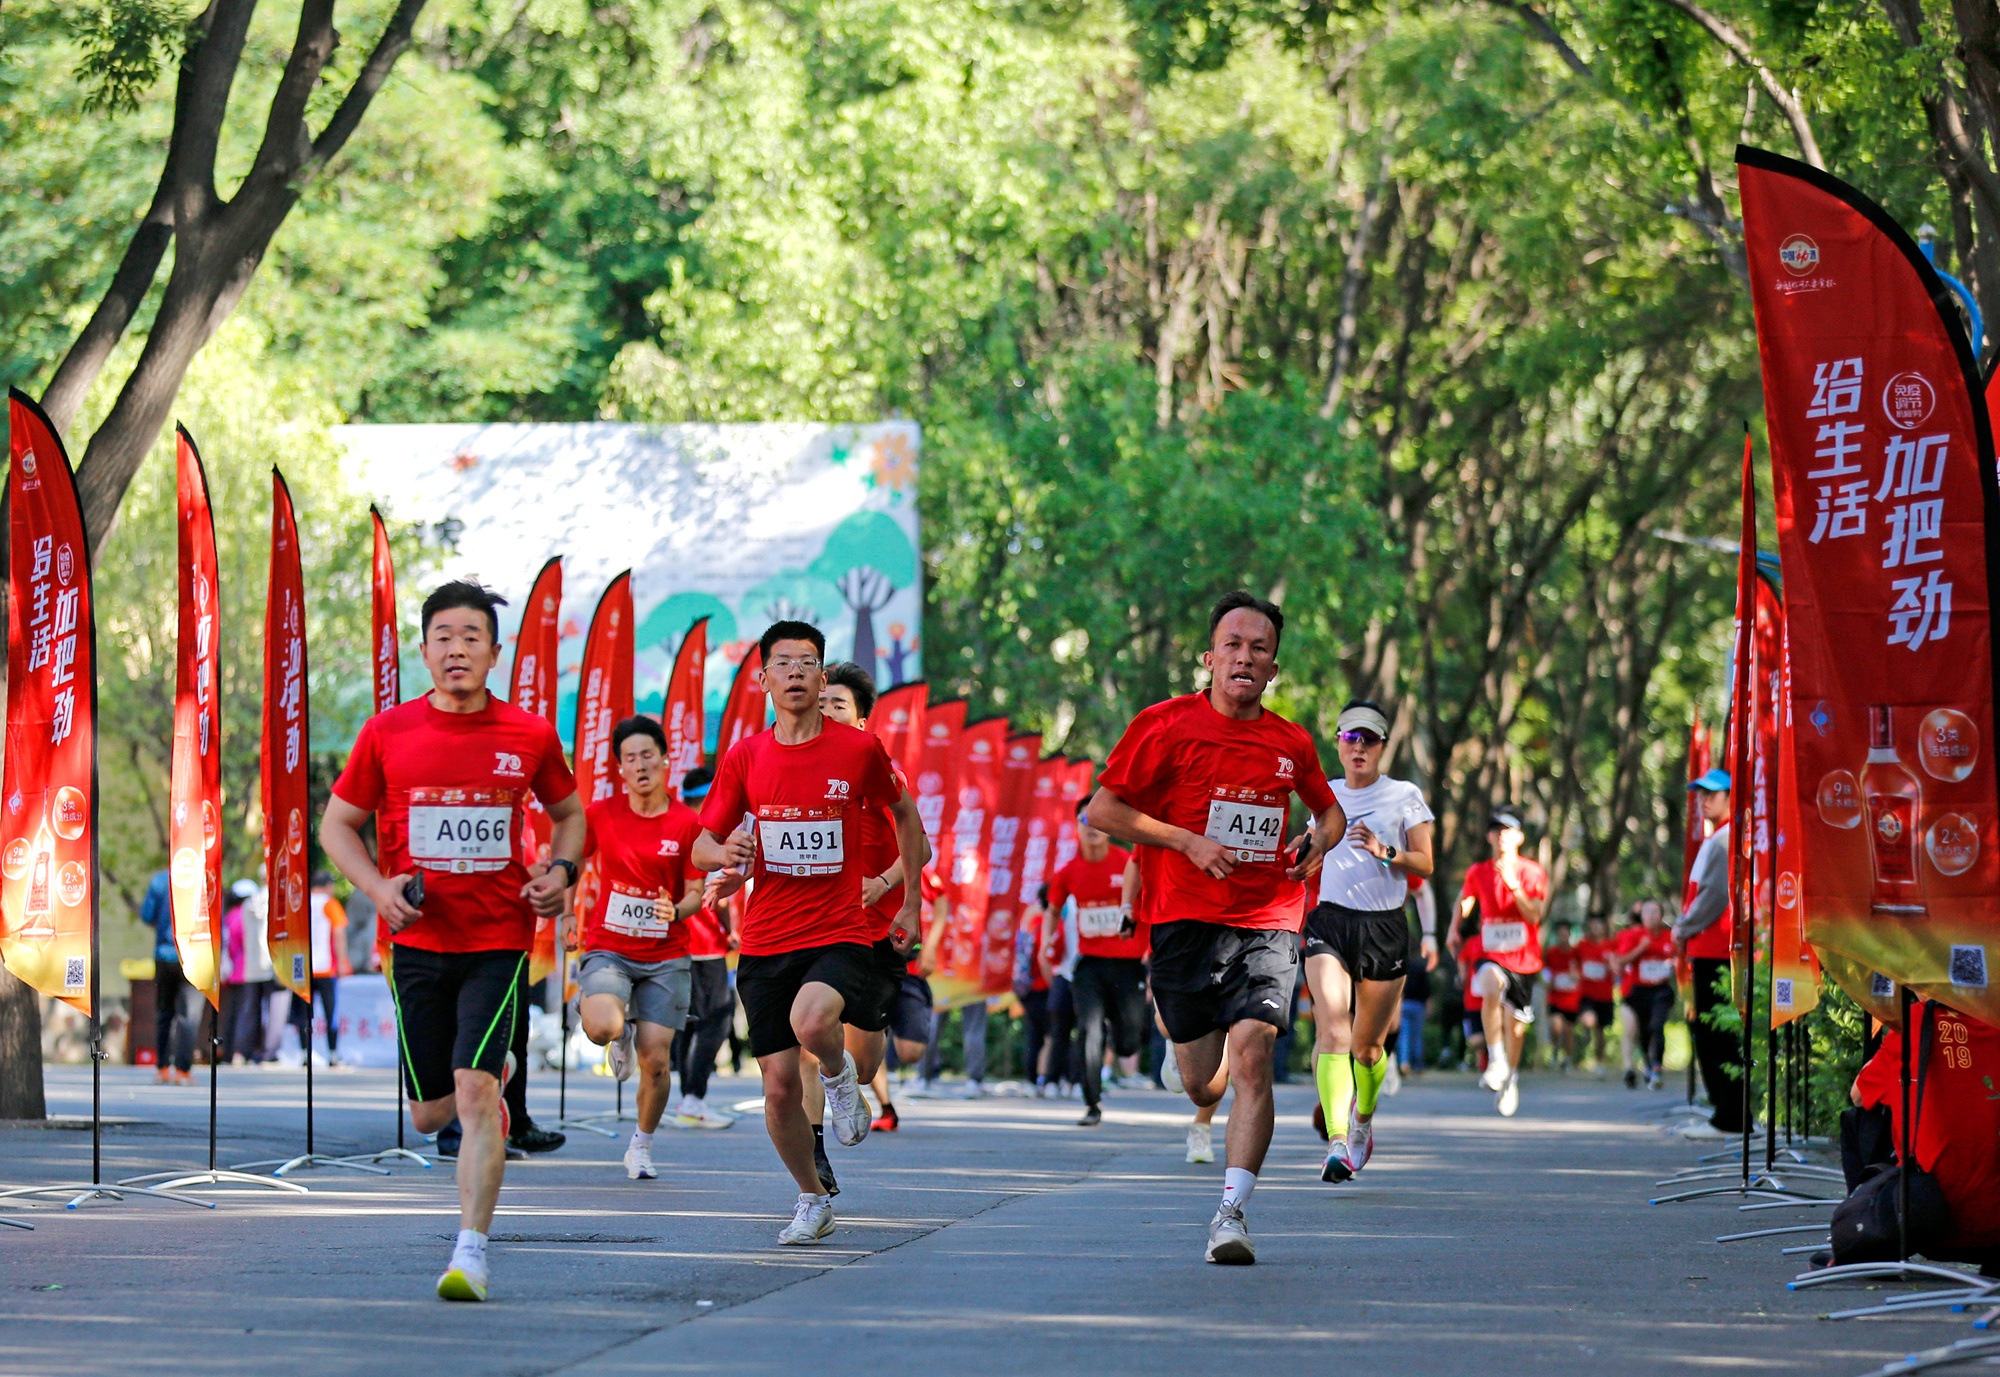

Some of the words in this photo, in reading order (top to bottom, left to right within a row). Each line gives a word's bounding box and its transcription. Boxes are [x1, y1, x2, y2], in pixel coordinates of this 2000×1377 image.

[1806, 357, 1869, 544] 给生活
[1873, 433, 1952, 652] 加把劲
[27, 534, 53, 673] 给生活
[51, 587, 79, 747] 加把劲
[495, 753, 522, 771] 70
[1278, 757, 1294, 773] 70
[827, 779, 850, 795] 70
[436, 819, 506, 842] A066
[1228, 814, 1280, 837] A142
[661, 840, 679, 853] 70
[779, 831, 838, 850] A191
[622, 904, 661, 919] A09
[1938, 1020, 1968, 1044] 20
[1943, 1046, 1972, 1069] 19
